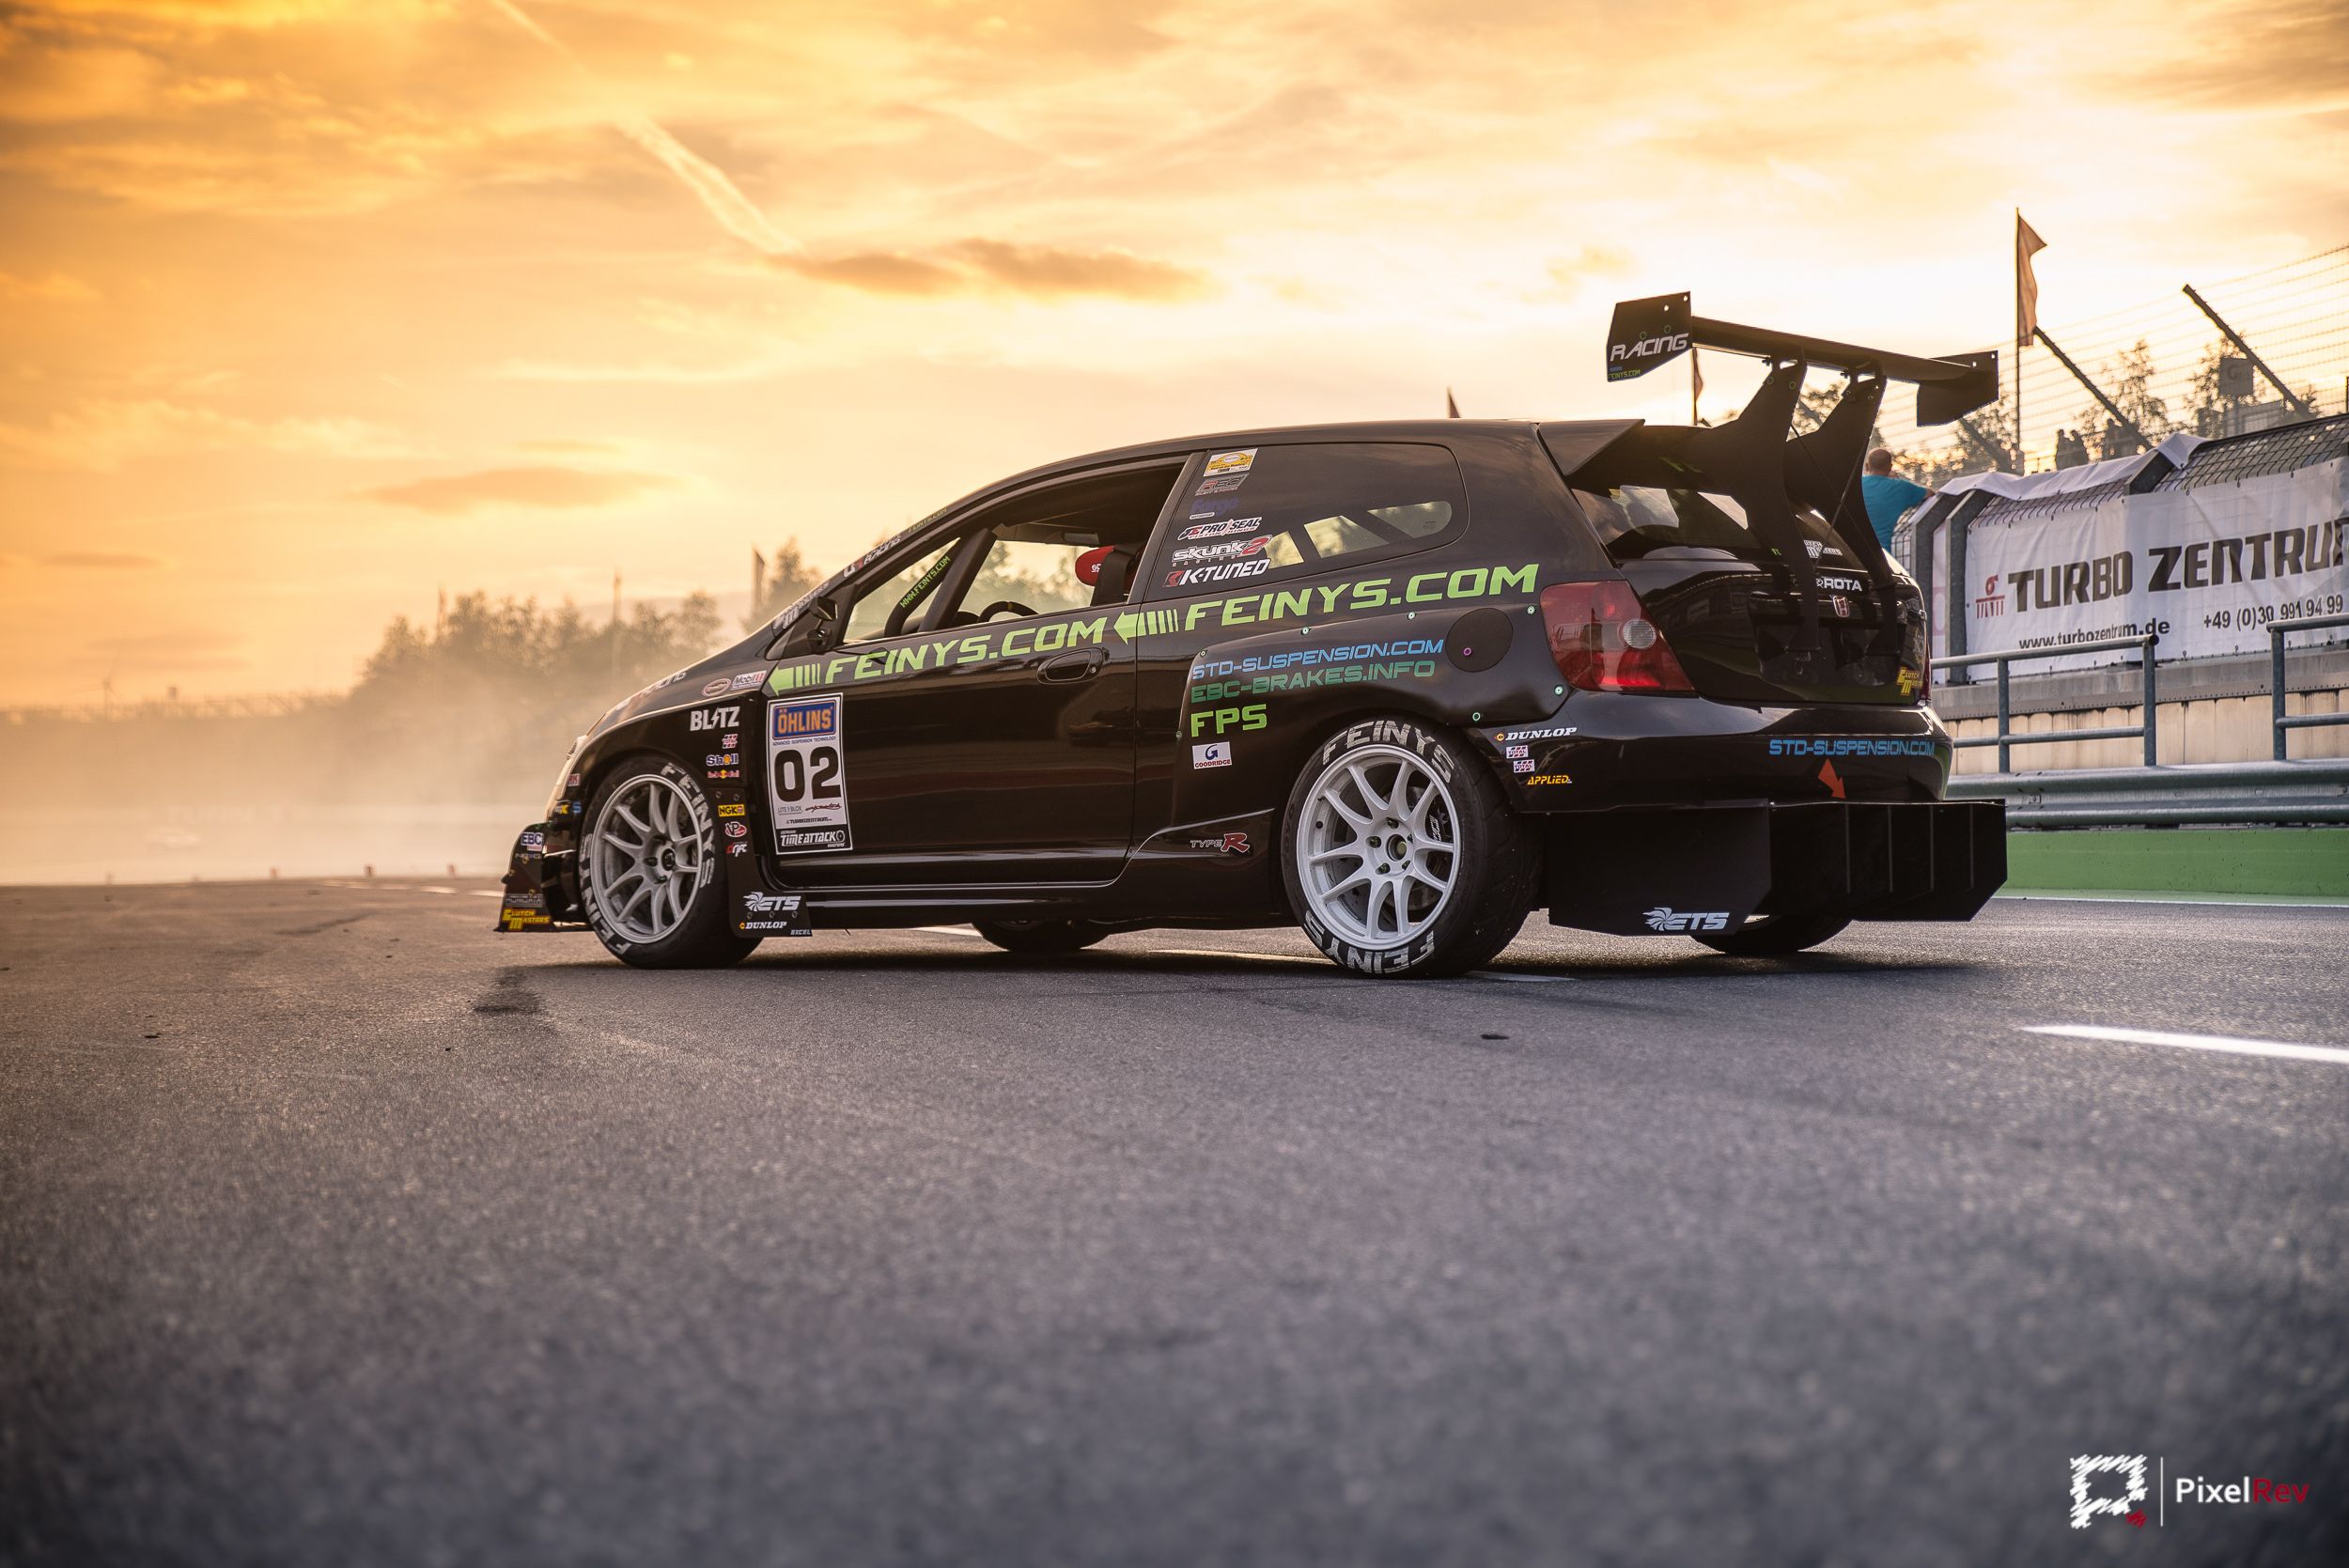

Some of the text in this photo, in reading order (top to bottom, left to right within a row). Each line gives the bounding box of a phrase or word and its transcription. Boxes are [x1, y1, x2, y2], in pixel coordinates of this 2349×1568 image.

[1610, 333, 1689, 362] RACING
[1201, 522, 1228, 535] PRO
[1229, 518, 1261, 530] SEAL
[899, 555, 951, 609] WWW.FEINYS.COM
[1179, 558, 1271, 586] K-TUNED
[1824, 576, 1863, 591] ROTA
[2007, 551, 2134, 613] TURBO
[1184, 564, 1539, 631] FEINYS.COM
[2203, 594, 2344, 631] +49 (0)30 991 94 99
[2019, 617, 2170, 649] www.turbozentrum.de
[825, 616, 1109, 685] FEINYS.COM
[1190, 660, 1436, 704] EBC-BRAKES.INFO
[778, 708, 832, 735] ÖHLINS
[1190, 704, 1268, 737] FPS
[1505, 727, 1578, 740] DUNLOP
[706, 753, 739, 767] Shll
[1195, 759, 1231, 768] GOODRIDGE
[1322, 720, 1455, 784] FEINYS
[773, 746, 842, 803] 02
[720, 806, 738, 815] NGK
[521, 832, 543, 846] EBC
[1190, 832, 1251, 854] TYPE R
[745, 922, 787, 930] DUNLOP
